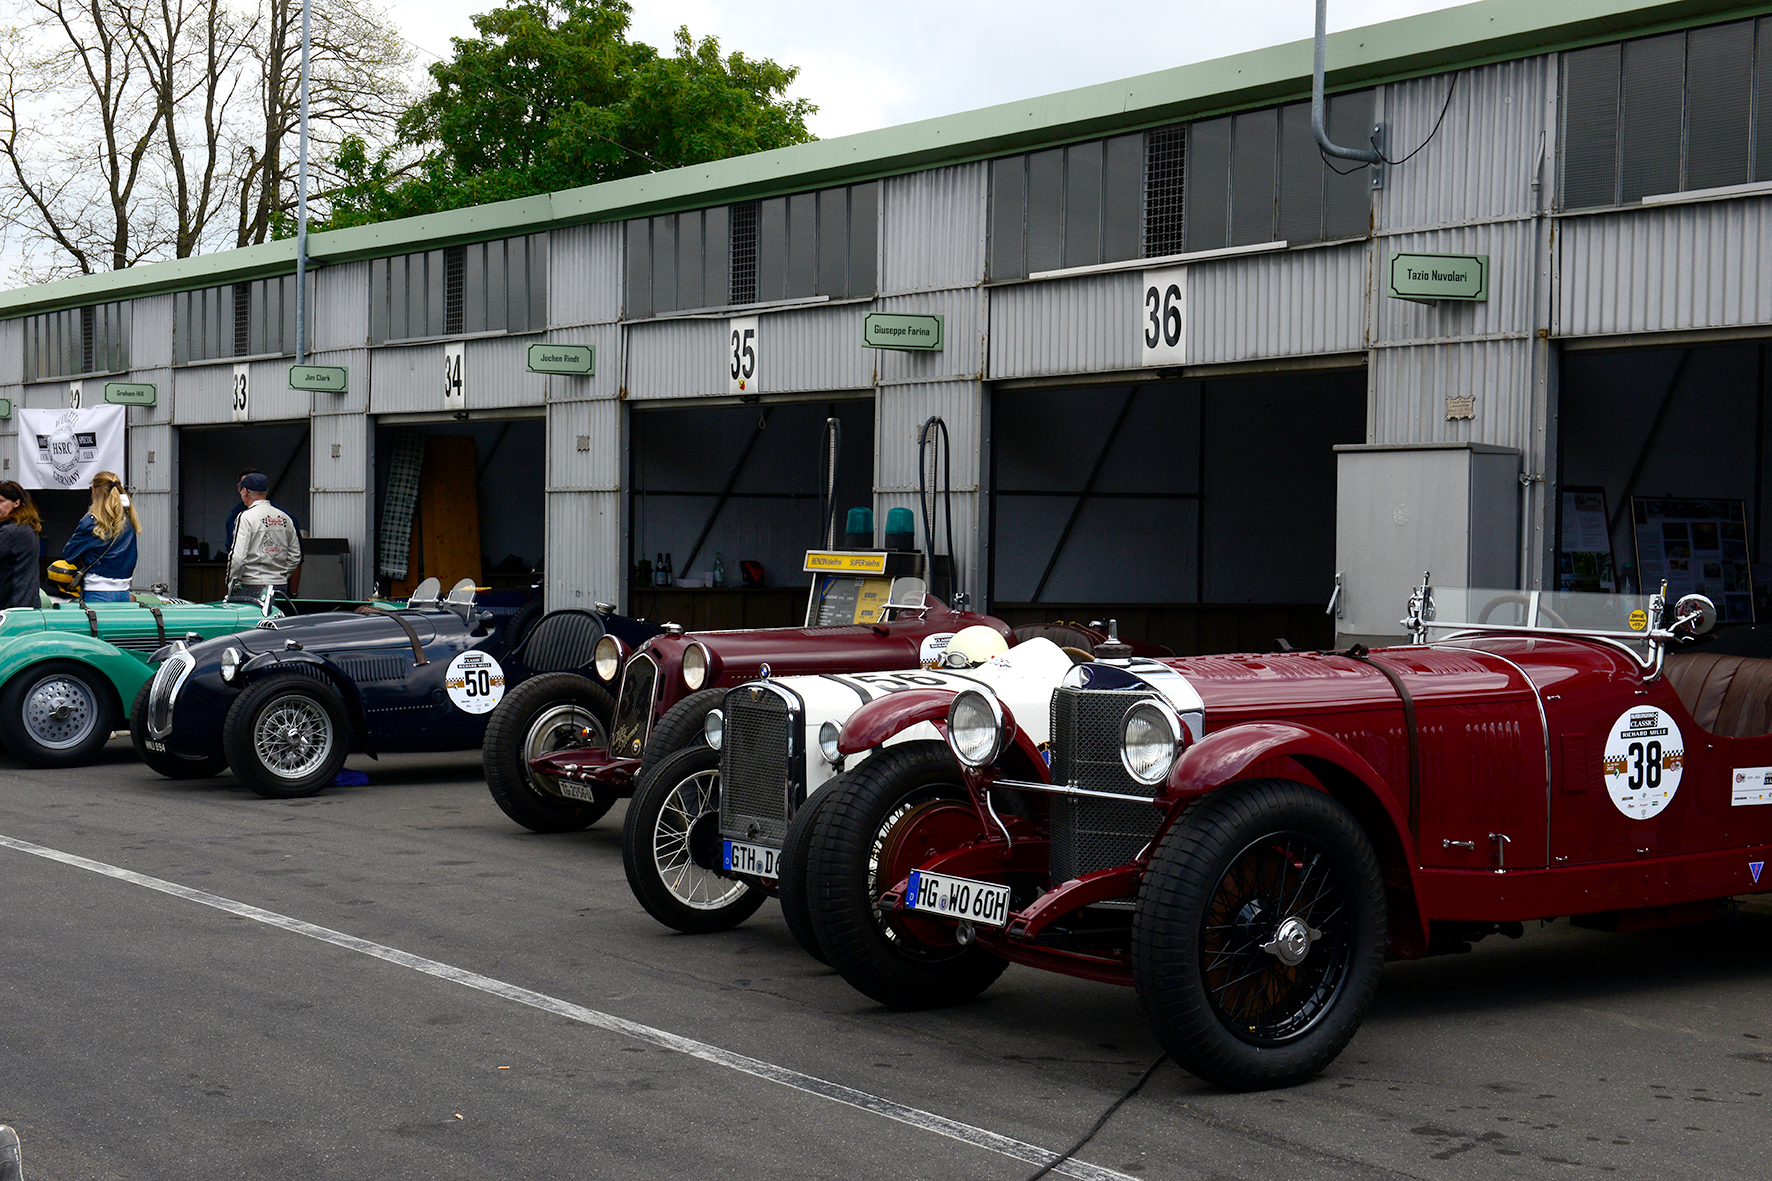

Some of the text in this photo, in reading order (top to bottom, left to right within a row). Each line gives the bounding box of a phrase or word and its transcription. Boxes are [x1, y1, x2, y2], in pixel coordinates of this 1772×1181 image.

[1407, 268, 1467, 282] Tazio Nuvolari
[1145, 284, 1182, 349] 36
[874, 324, 930, 336] Giuseppe Farina
[540, 353, 580, 363] Jochen Rindt
[731, 329, 755, 380] 35
[444, 354, 462, 397] 34
[233, 373, 246, 411] 33
[52, 442, 73, 455] HSRC
[52, 470, 80, 486] GERMANY
[811, 557, 827, 565] BENZIN
[850, 559, 865, 567] SUPER
[464, 669, 490, 697] 50
[849, 674, 947, 693] 56
[1630, 720, 1655, 728] CLASSIC
[1622, 730, 1648, 738] RICHARD
[1628, 740, 1662, 790] 38
[731, 845, 756, 871] GTH
[764, 850, 774, 874] D
[916, 877, 1007, 921] HG WO 60H
